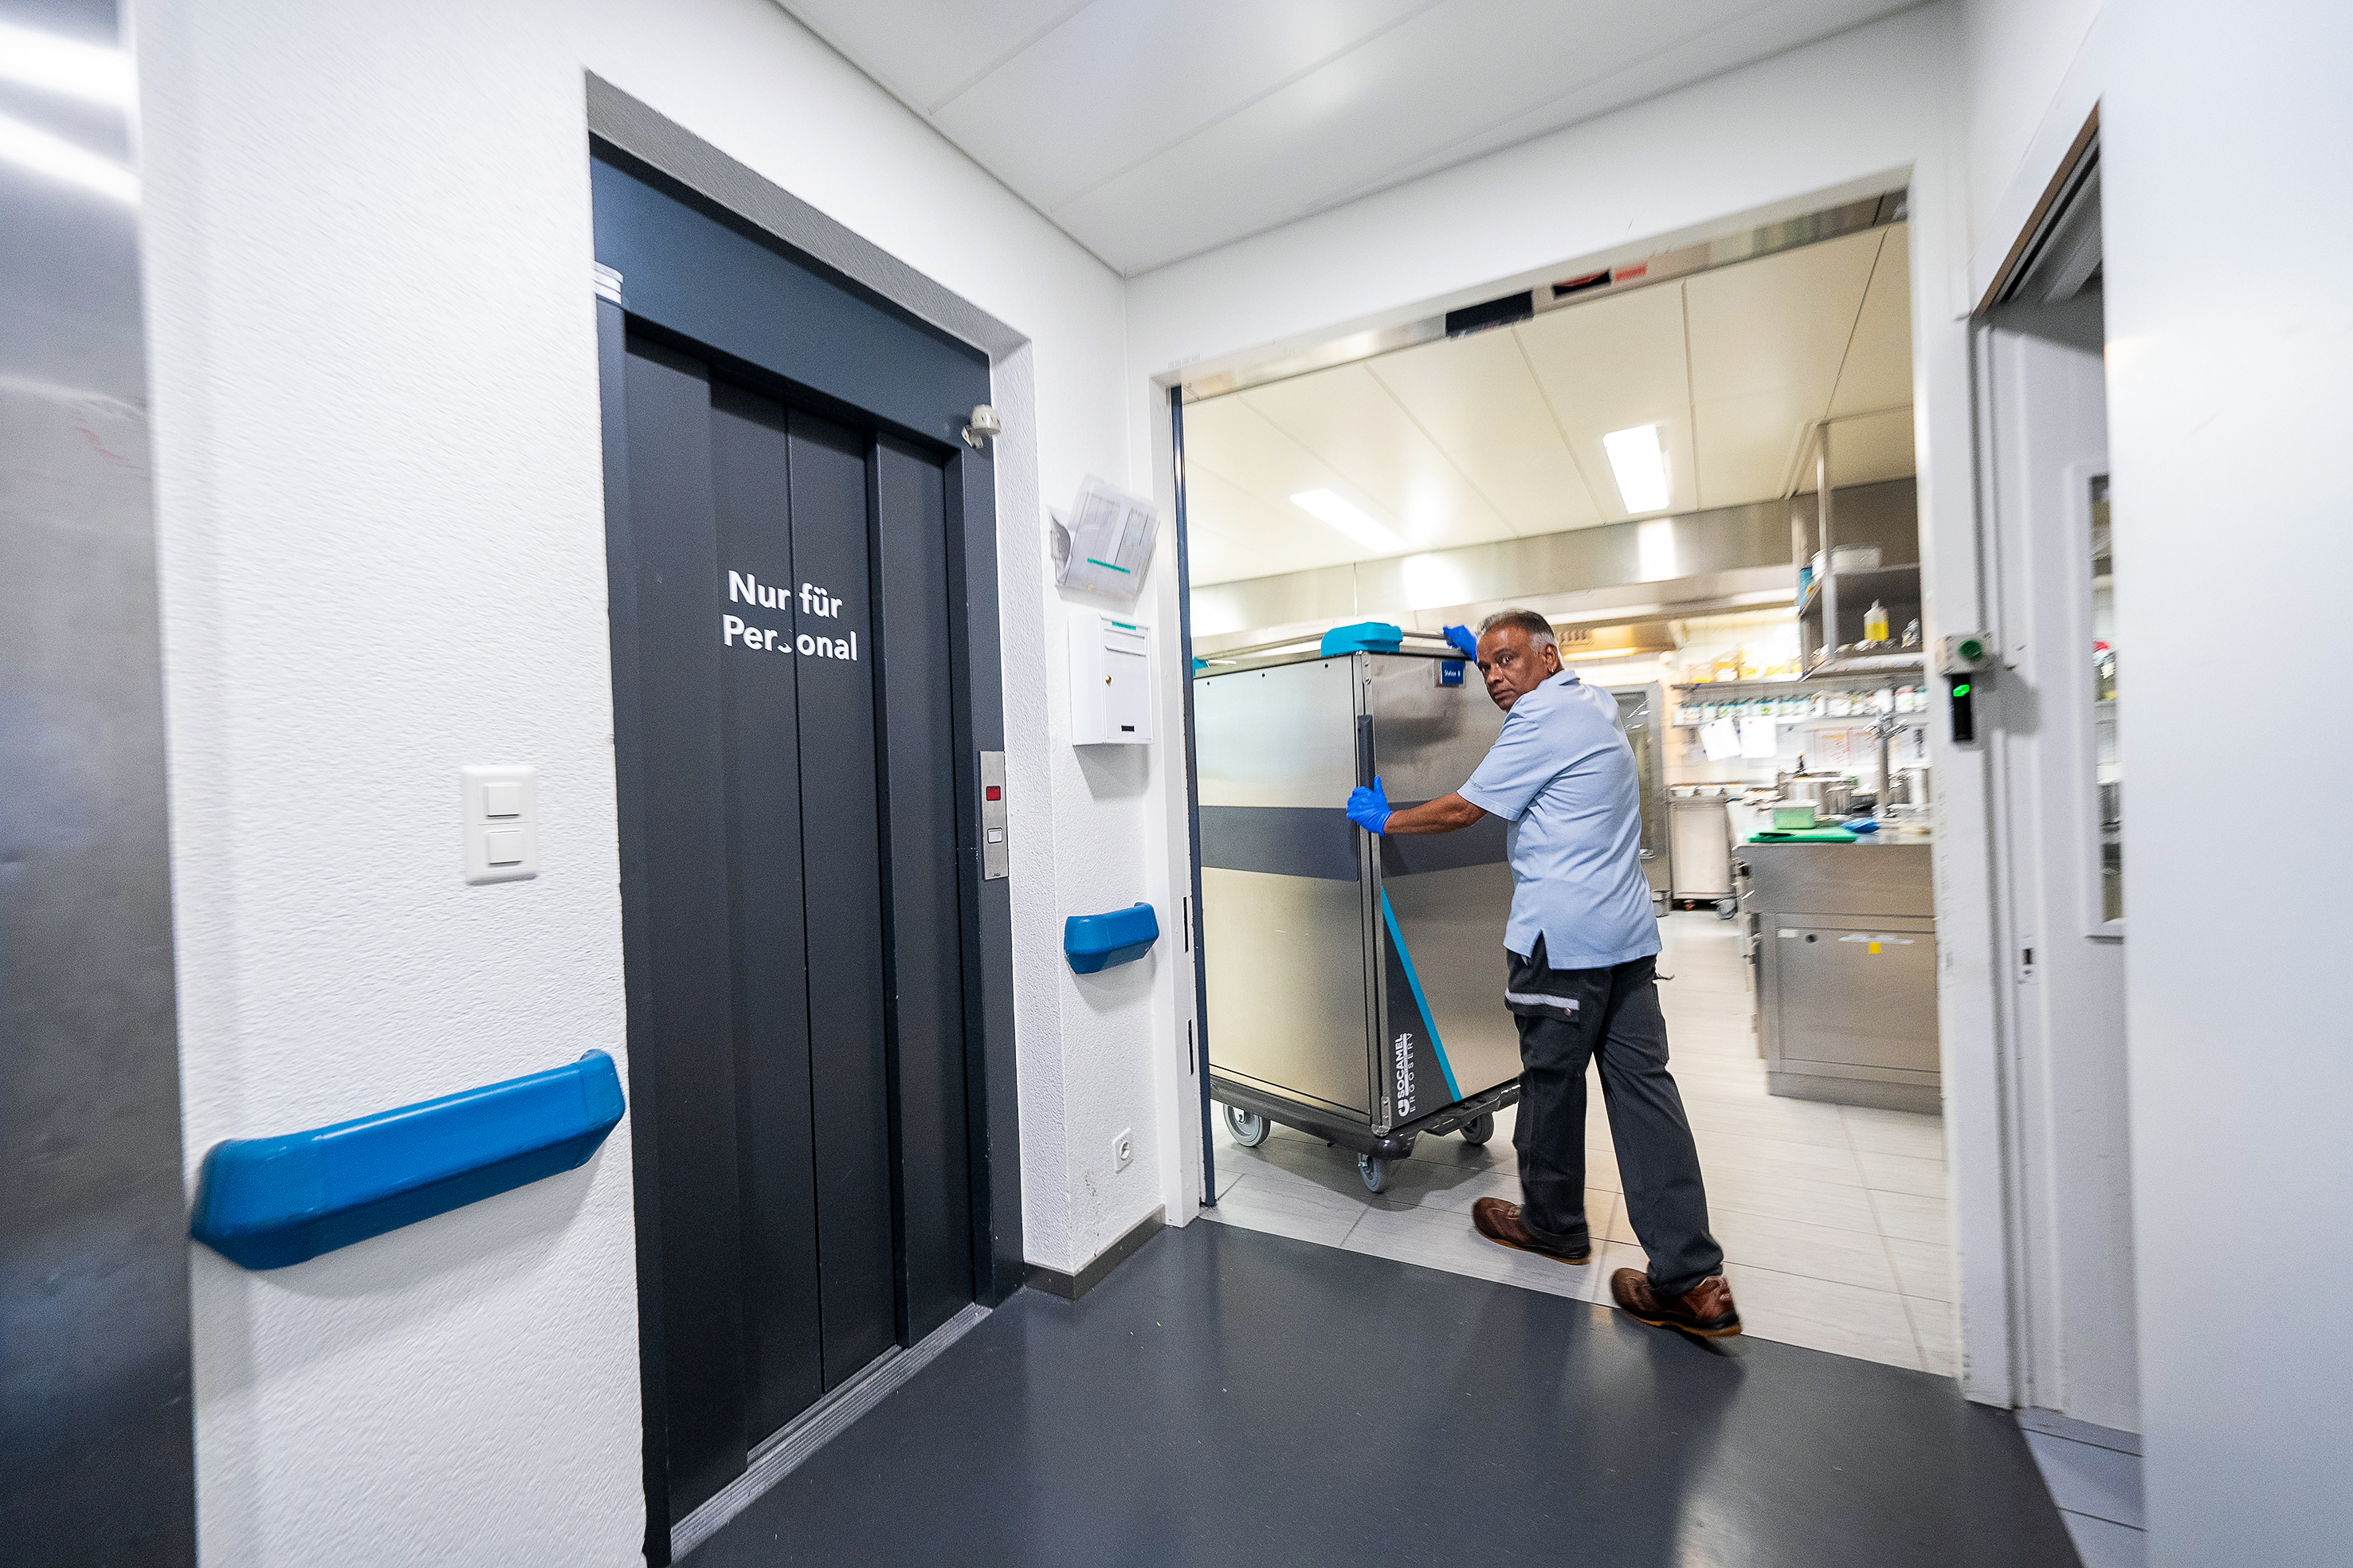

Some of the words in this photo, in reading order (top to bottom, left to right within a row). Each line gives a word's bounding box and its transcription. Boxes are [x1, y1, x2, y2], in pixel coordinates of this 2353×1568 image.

[727, 569, 791, 611] Nur
[798, 582, 843, 619] für
[1394, 1033, 1405, 1099] SOCAMEL
